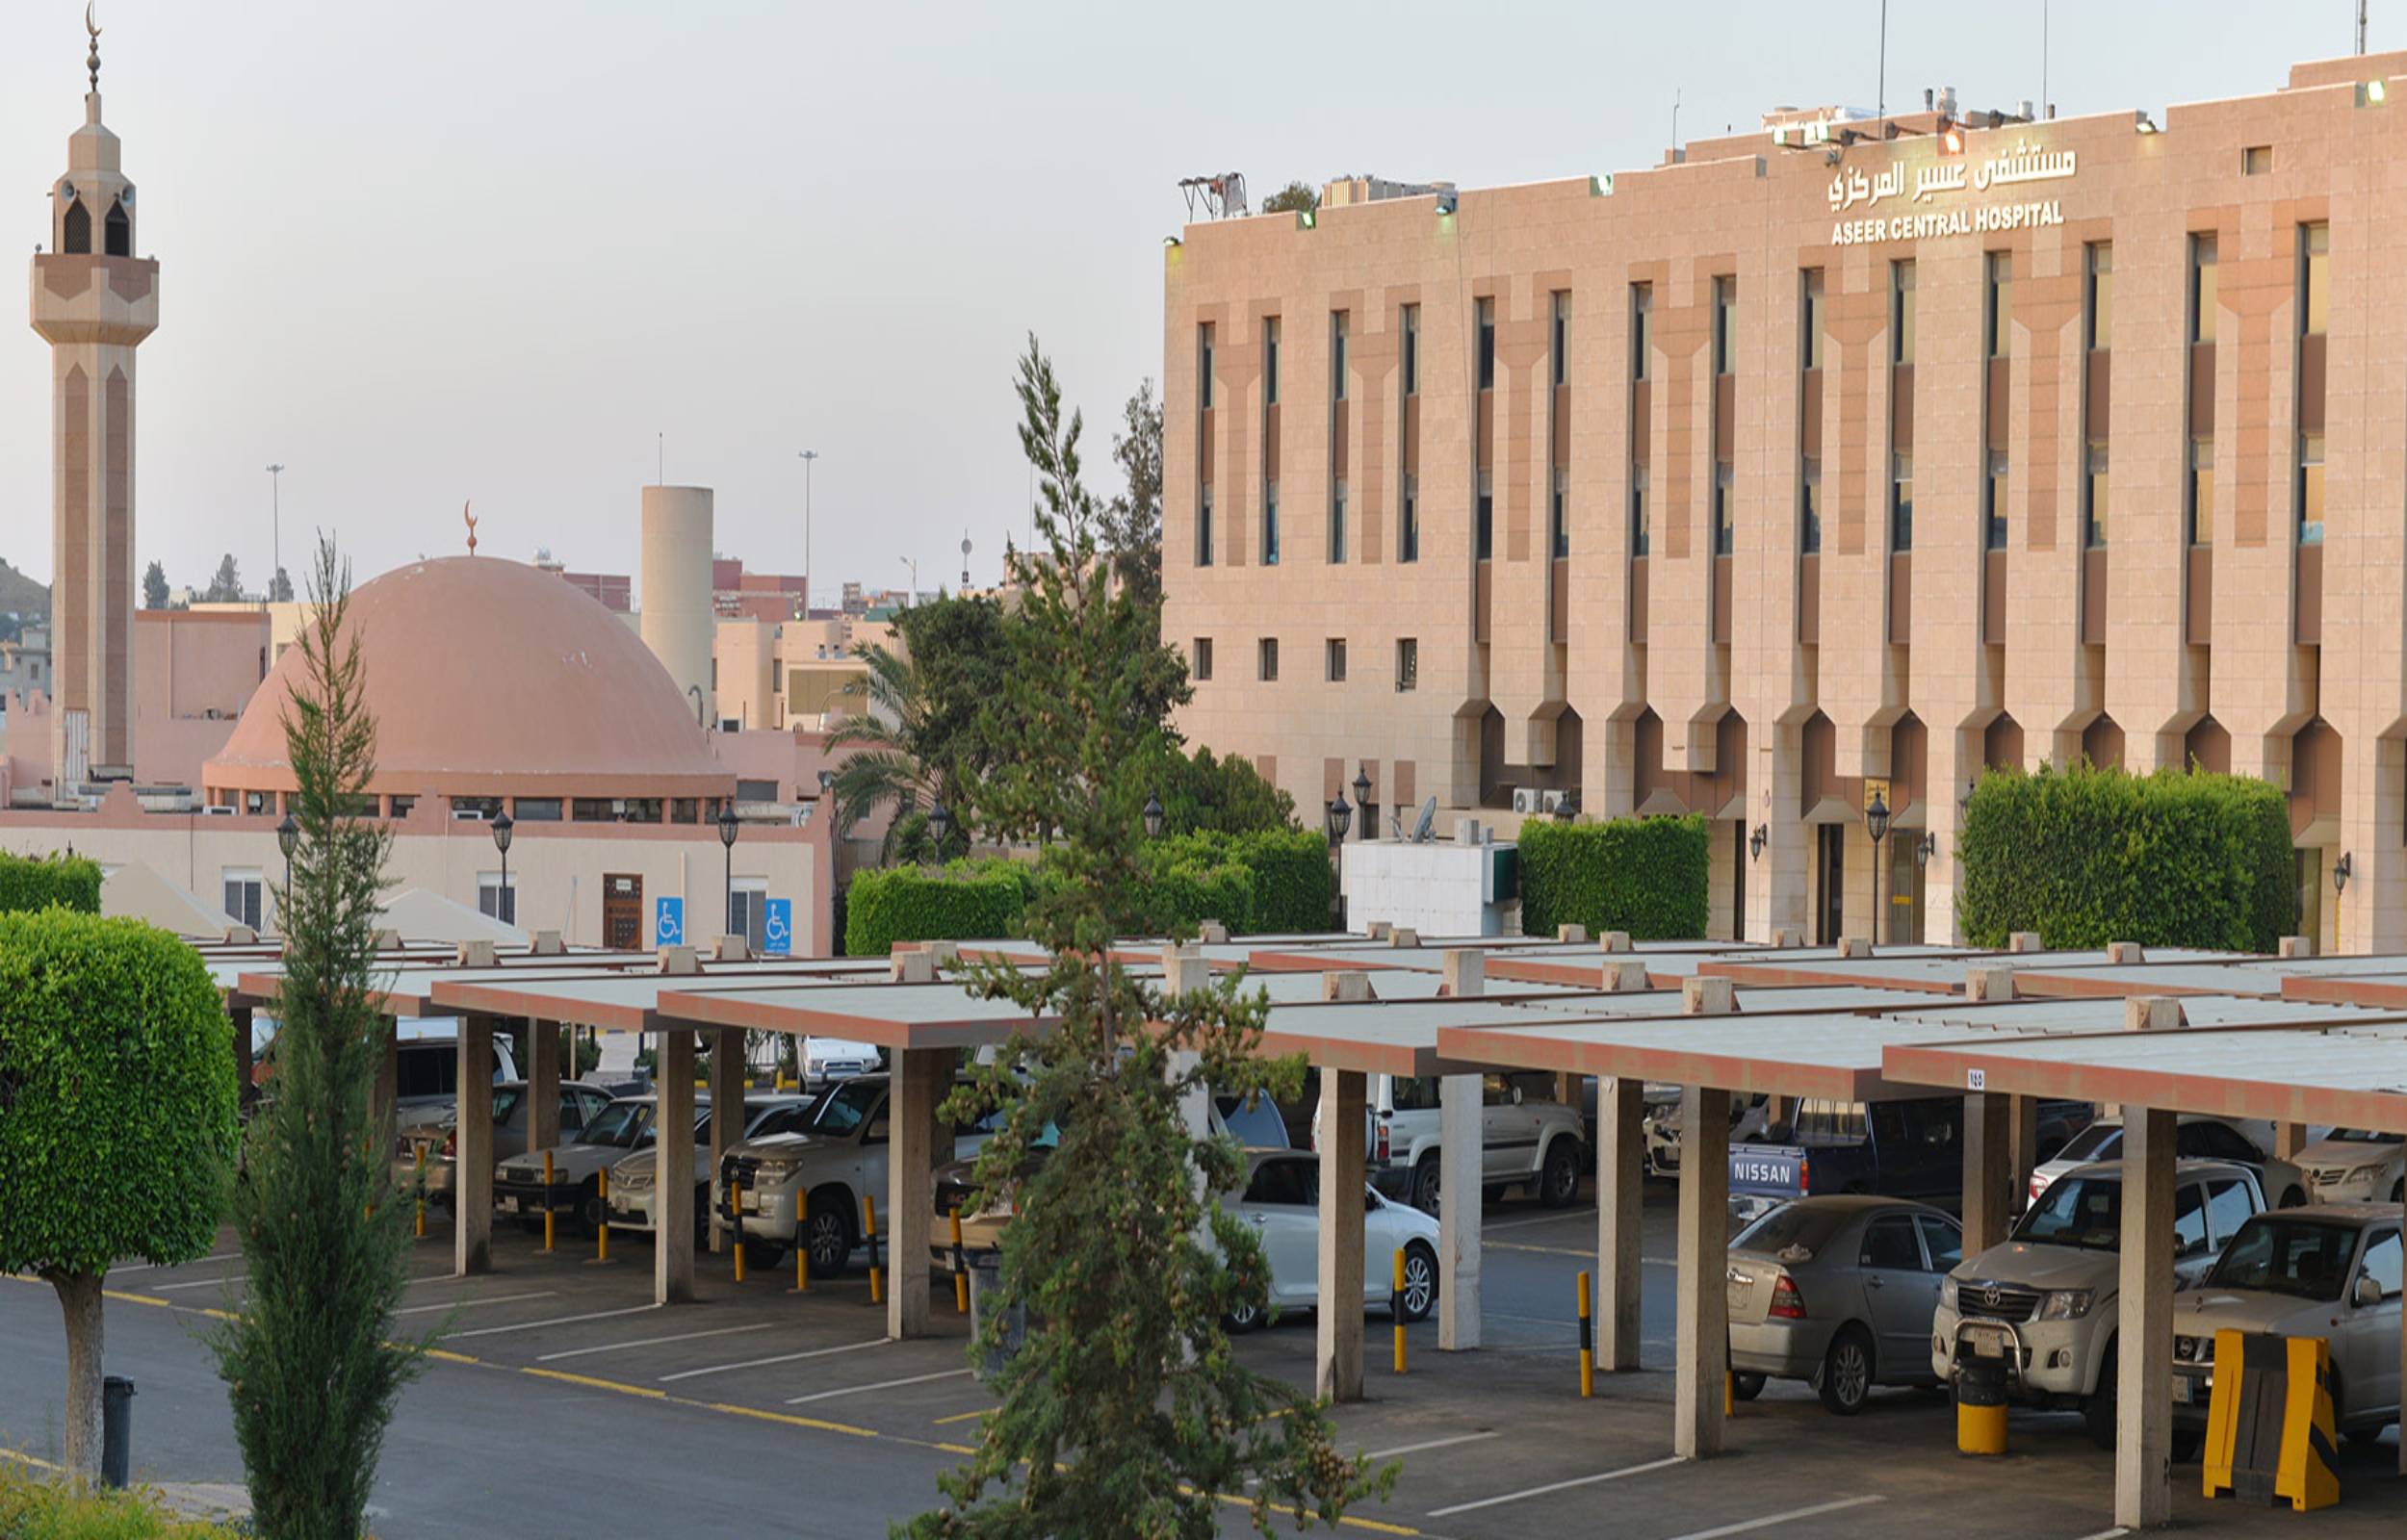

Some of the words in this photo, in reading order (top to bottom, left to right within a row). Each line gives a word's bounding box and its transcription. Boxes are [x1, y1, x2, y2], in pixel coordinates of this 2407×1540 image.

[1912, 163, 1966, 202] عسير
[1974, 138, 2076, 190] مستشفى
[1828, 161, 1904, 213] المركزي
[1832, 219, 1886, 245] ASEER
[1891, 210, 1971, 240] CENTRAL
[1975, 200, 2064, 232] HOSPITAL
[1734, 1162, 1790, 1184] NISSAN
